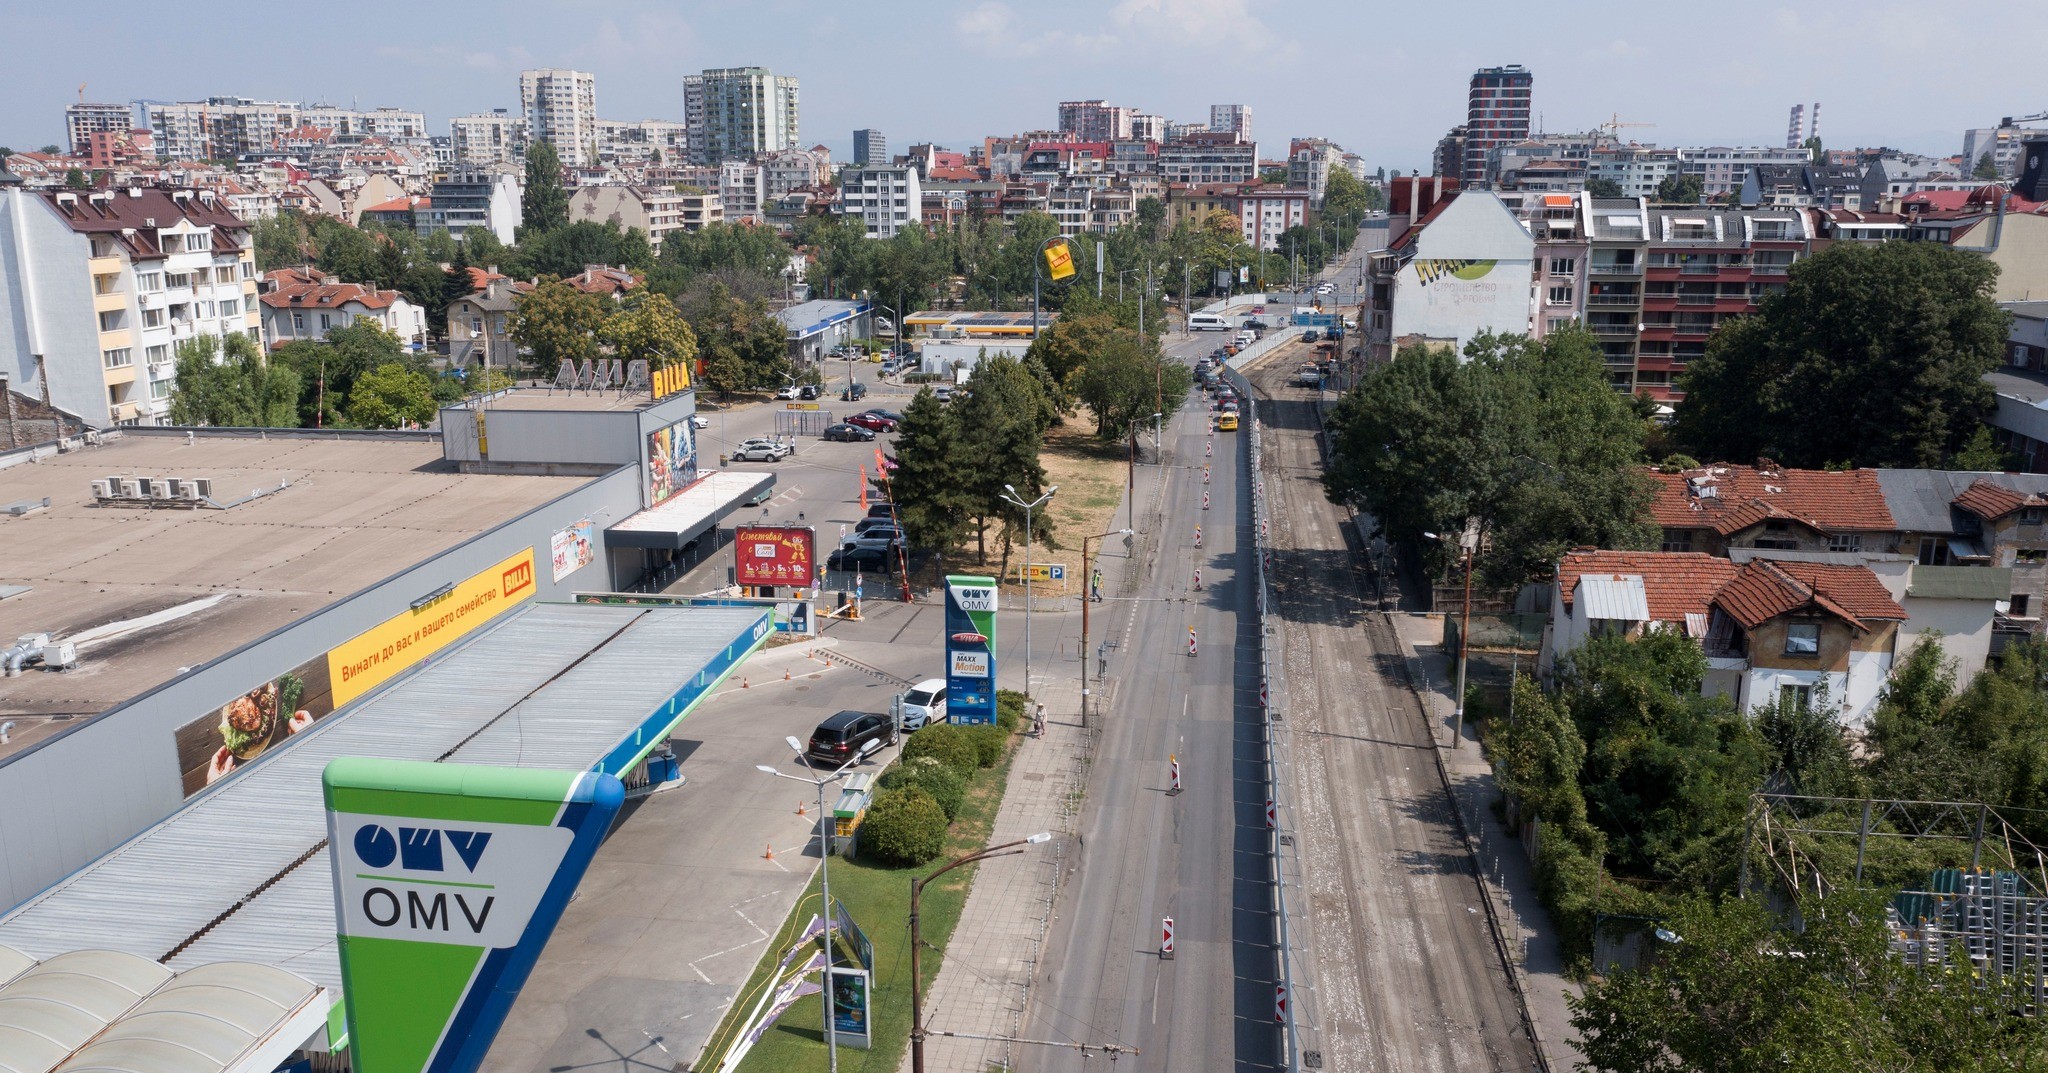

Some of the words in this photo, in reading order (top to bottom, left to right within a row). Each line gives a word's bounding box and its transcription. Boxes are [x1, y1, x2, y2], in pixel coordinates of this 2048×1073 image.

[651, 361, 691, 400] BILLA
[504, 565, 530, 592] BILLA
[1053, 568, 1062, 578] P
[962, 600, 990, 610] OMV
[342, 651, 380, 682] Винаги
[382, 643, 394, 662] до
[396, 636, 413, 652] вас
[414, 630, 421, 642] и
[422, 613, 455, 638] вашето
[455, 588, 497, 619] семейство
[753, 618, 768, 640] OMV
[955, 662, 986, 672] Motion
[956, 655, 977, 663] MAXX
[362, 887, 496, 934] OMV
